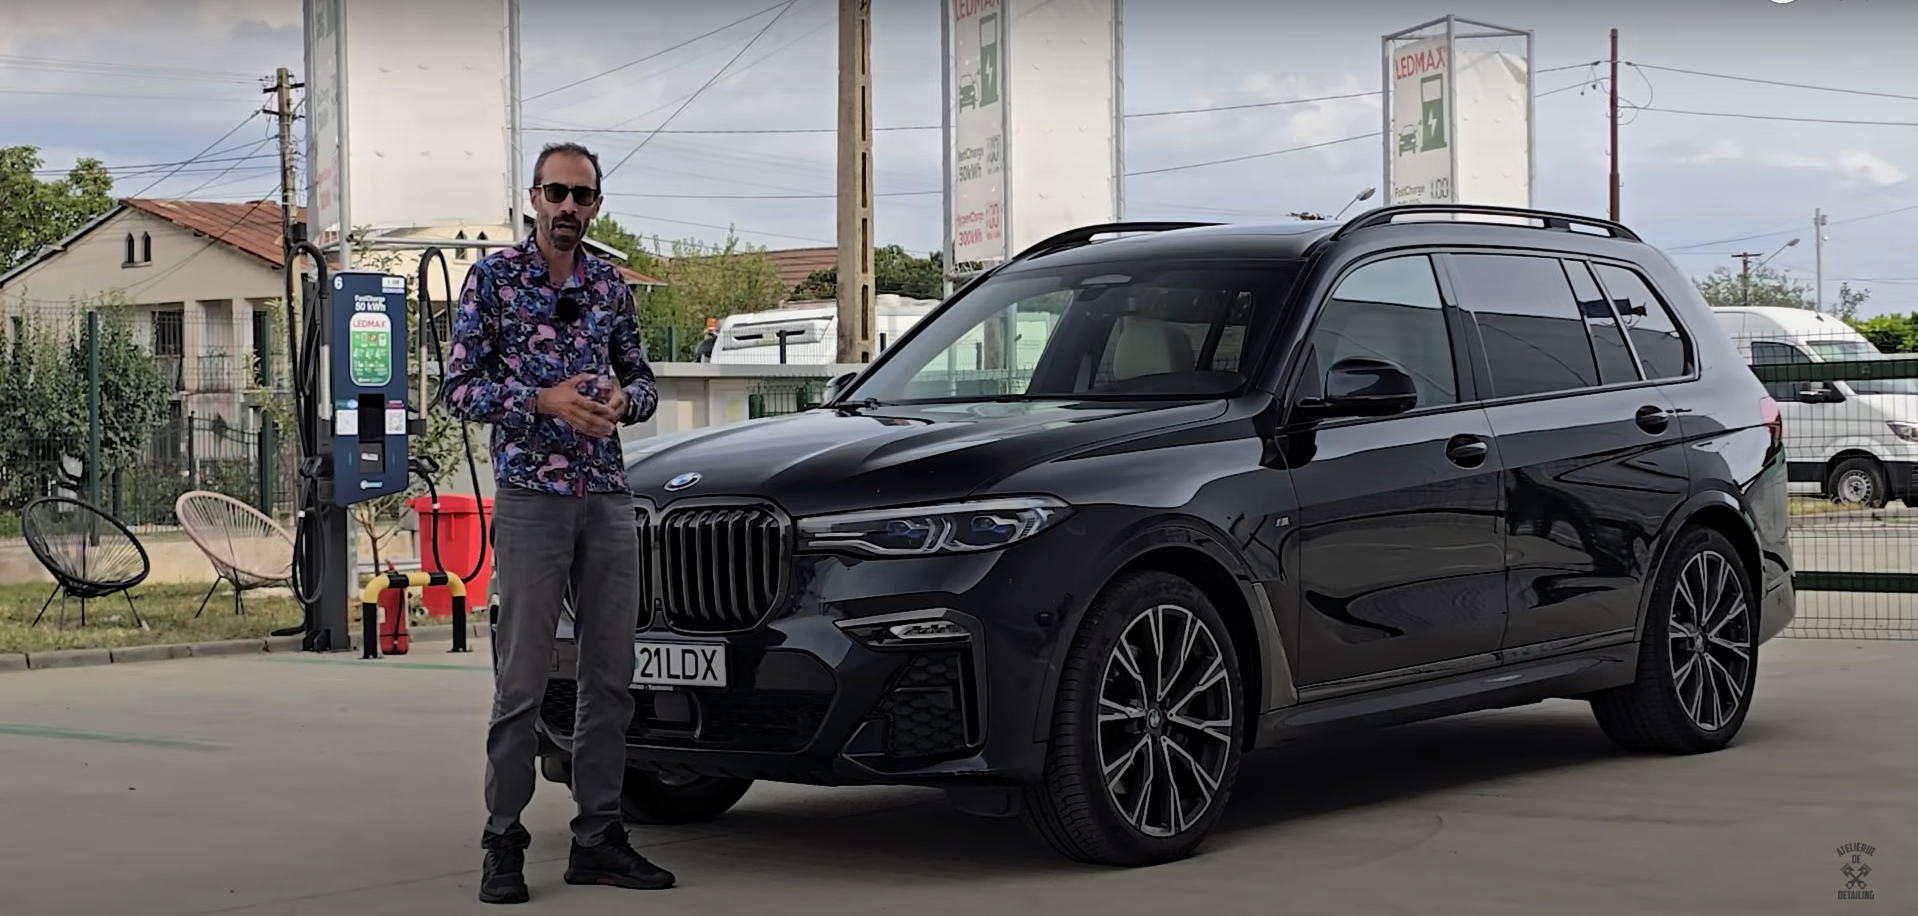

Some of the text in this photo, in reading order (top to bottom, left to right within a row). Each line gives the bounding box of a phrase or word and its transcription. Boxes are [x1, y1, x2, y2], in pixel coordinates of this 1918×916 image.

[1394, 46, 1446, 80] LEDMAX
[1395, 185, 1425, 198] FastCharge
[334, 276, 343, 290] 6
[355, 300, 386, 312] 50 kWh
[352, 319, 386, 328] LEDMAX
[639, 647, 718, 681] 21LDX
